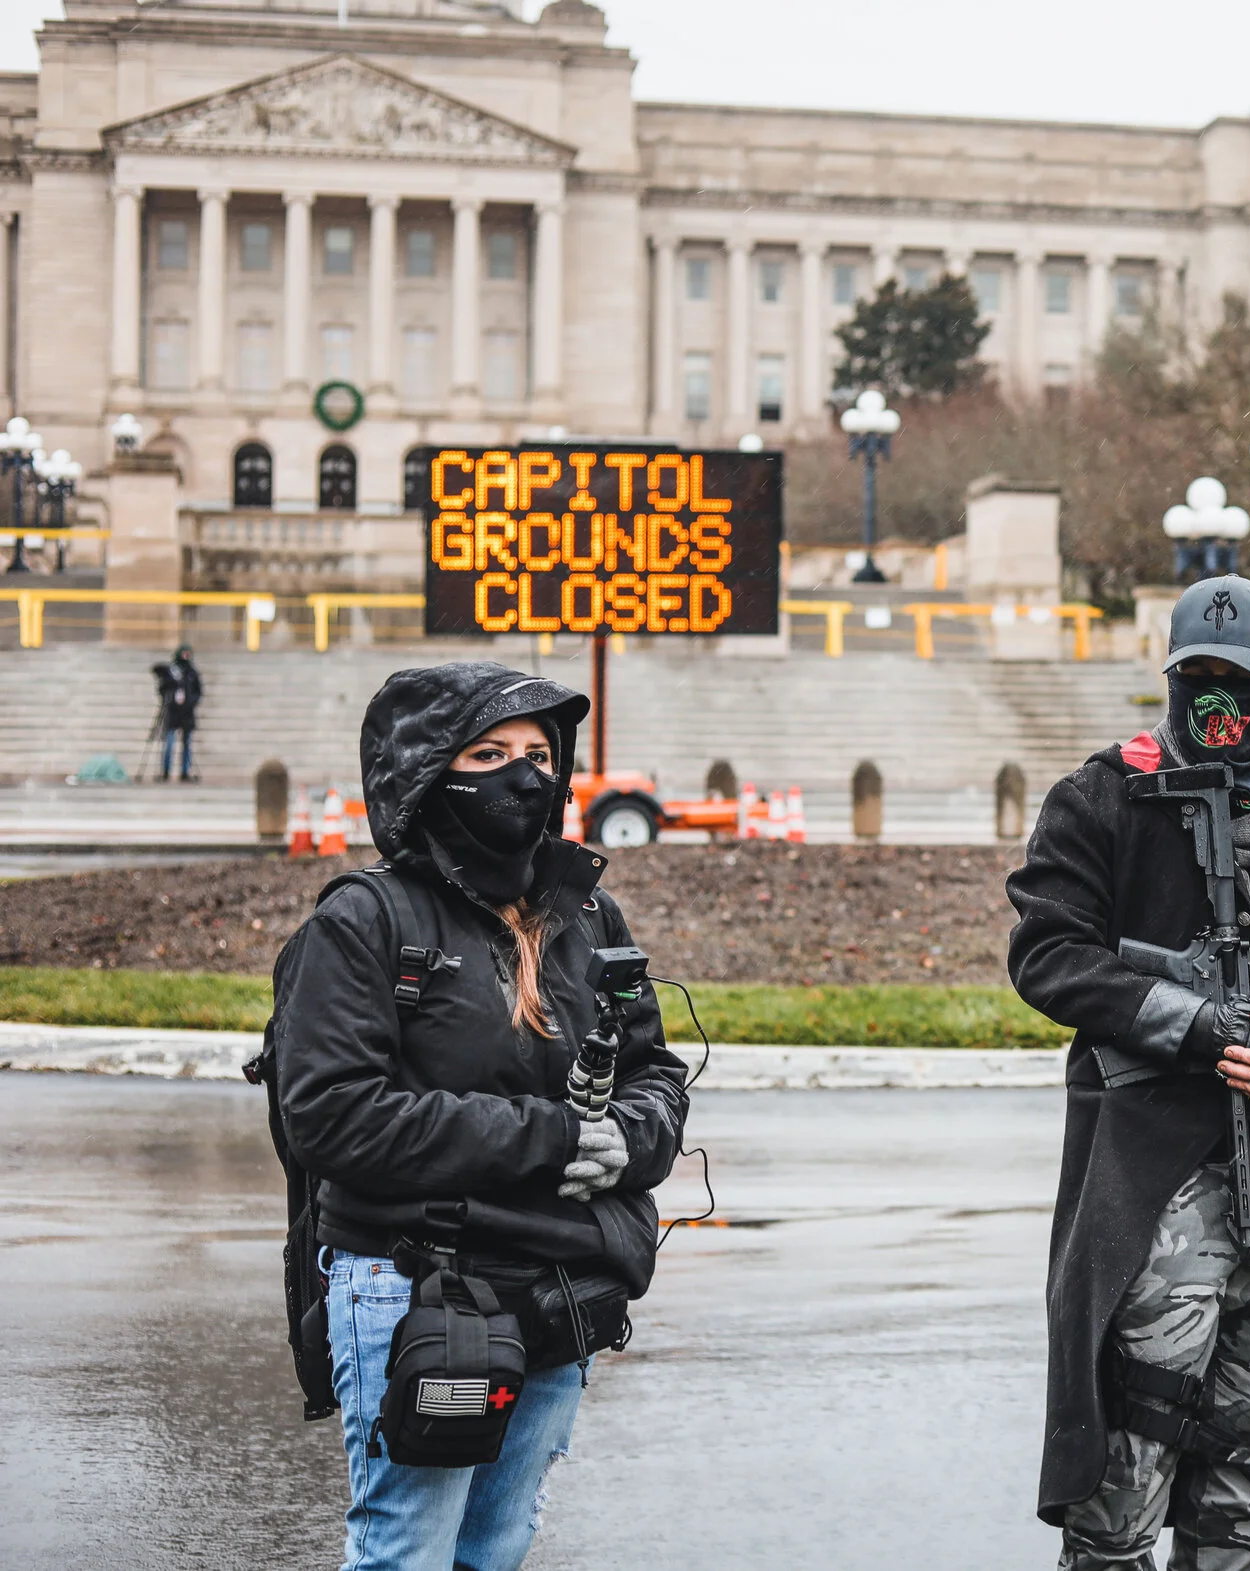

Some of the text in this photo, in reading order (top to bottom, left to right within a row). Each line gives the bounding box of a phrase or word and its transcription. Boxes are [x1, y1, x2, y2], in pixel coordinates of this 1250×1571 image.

[431, 450, 732, 512] CAPITOL
[431, 511, 732, 572] GROUNDS
[474, 572, 732, 632] CLOSED
